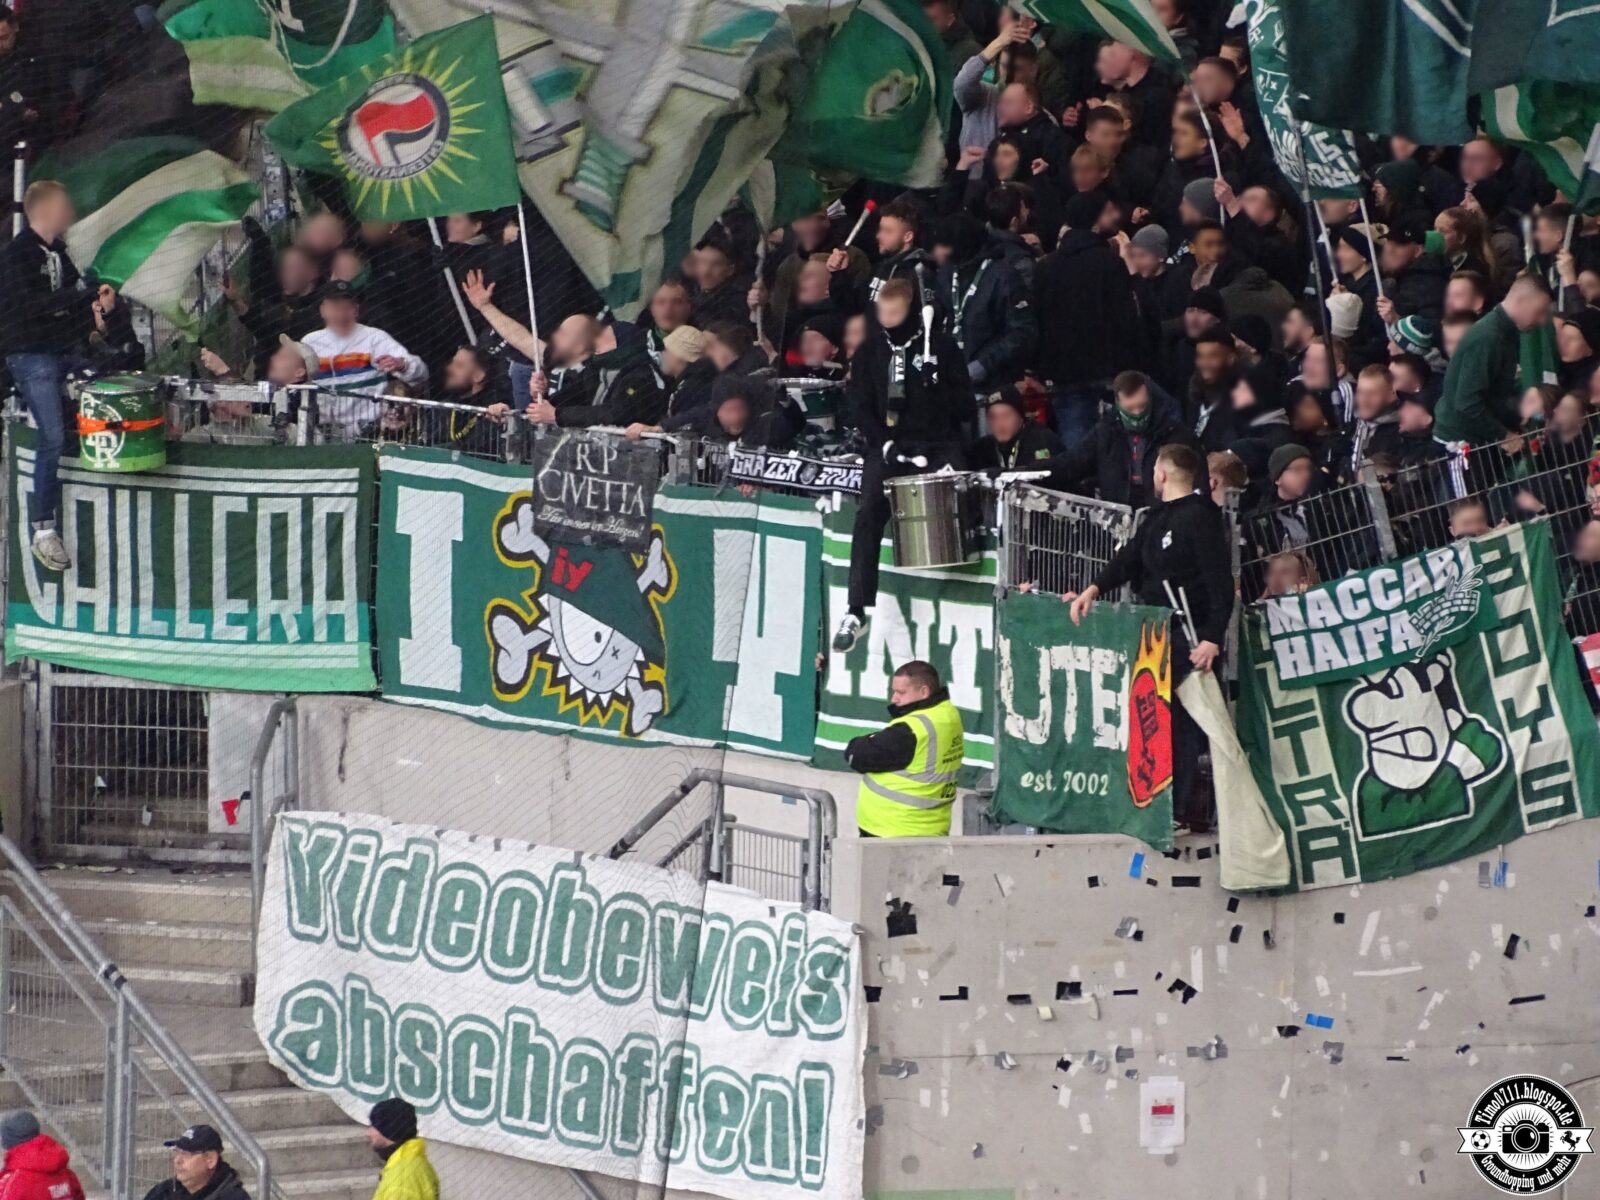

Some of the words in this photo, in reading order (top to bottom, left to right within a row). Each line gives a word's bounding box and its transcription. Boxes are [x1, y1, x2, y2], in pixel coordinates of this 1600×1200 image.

[538, 462, 646, 517] CIVETTA
[731, 451, 802, 482] GRAZER
[1266, 540, 1475, 636] MACCABI
[1273, 609, 1425, 680] HAIFA
[1479, 535, 1577, 827] BOYS
[1020, 769, 1057, 792] est.
[283, 817, 852, 1042] Videobeweis
[269, 974, 834, 1191] abschaffen!
